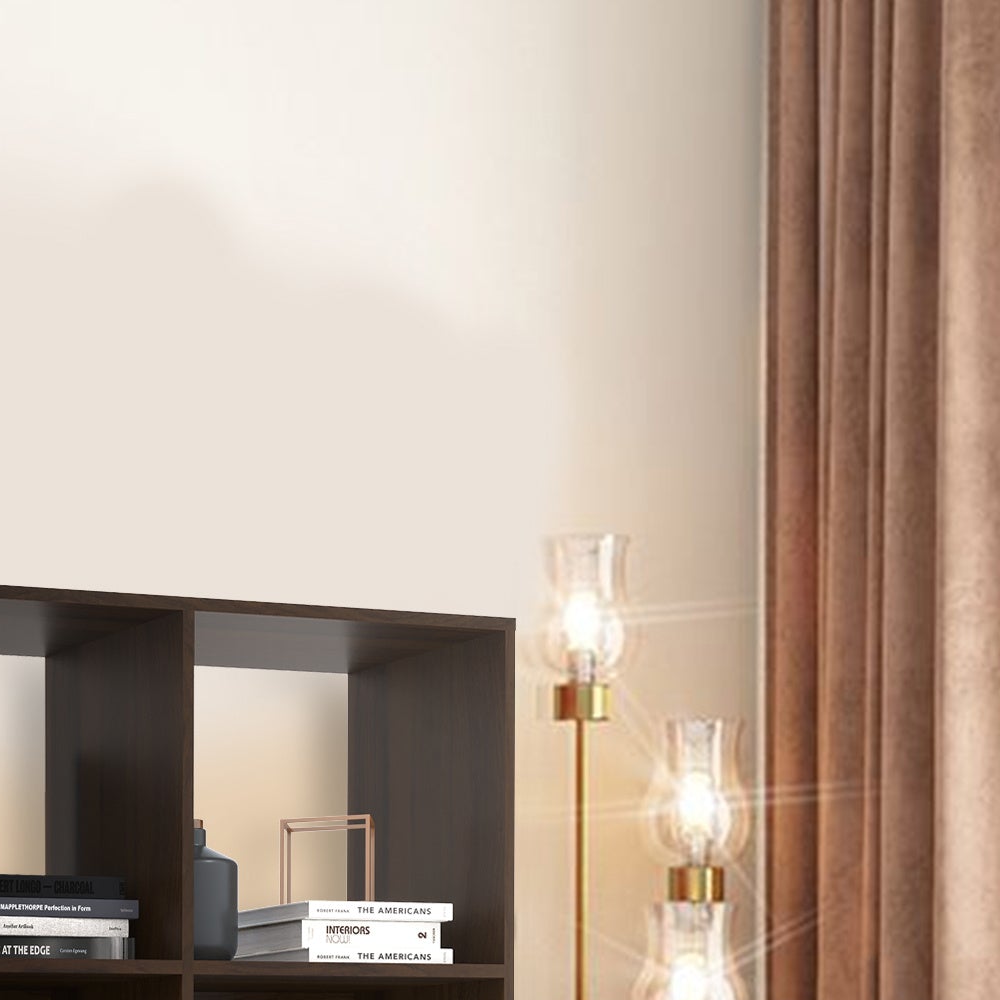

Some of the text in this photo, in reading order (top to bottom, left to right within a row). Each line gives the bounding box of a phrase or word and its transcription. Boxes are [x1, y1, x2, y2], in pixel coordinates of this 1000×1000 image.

[0, 904, 43, 912] MAPPLETHORPE
[378, 907, 432, 915] AMERICANS
[326, 925, 370, 935] INTERIORS
[326, 935, 351, 944] NOW!
[2, 945, 12, 955] AT
[13, 945, 28, 955] THE
[30, 945, 50, 955] EDGE
[358, 952, 374, 960] THE
[378, 953, 432, 961] AMERICANS
